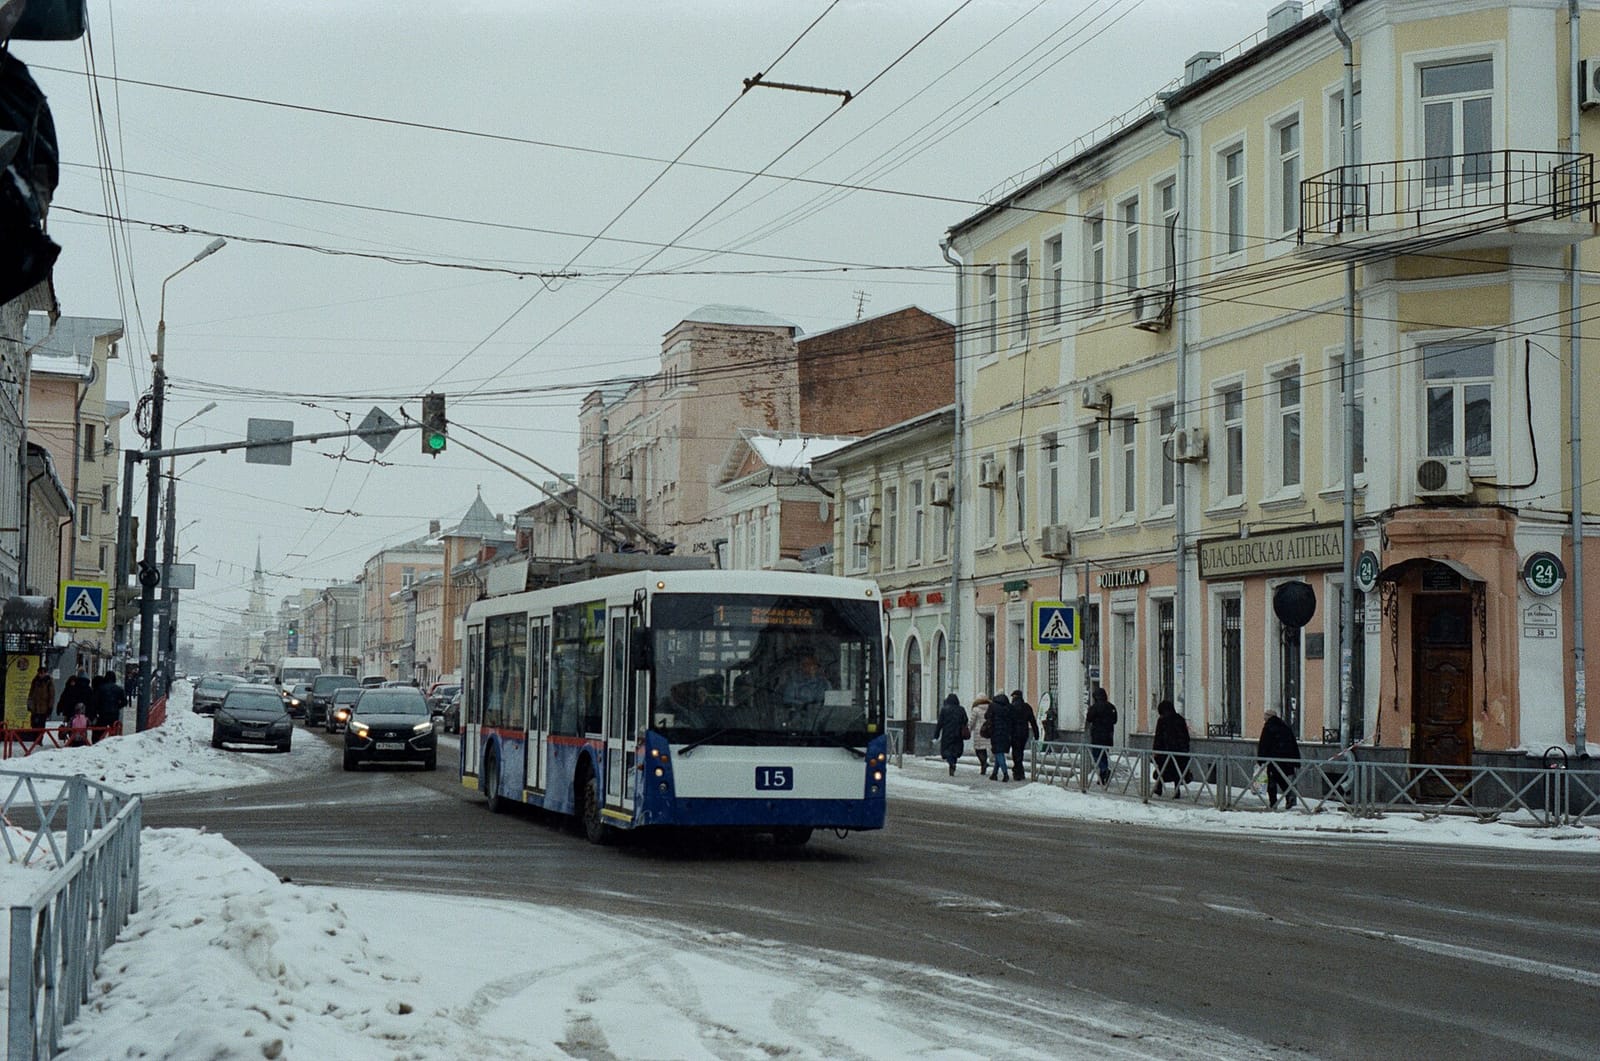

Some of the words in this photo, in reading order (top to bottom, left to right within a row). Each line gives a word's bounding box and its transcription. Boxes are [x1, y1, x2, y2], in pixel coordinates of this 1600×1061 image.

[1202, 540, 1283, 569] ВЛАСЬЕВСКАЯ
[1287, 533, 1341, 560] АПТЕКА
[1361, 562, 1372, 576] 24
[1535, 565, 1554, 579] 24
[1102, 569, 1139, 588] ОПТИКА
[764, 770, 786, 787] 15
